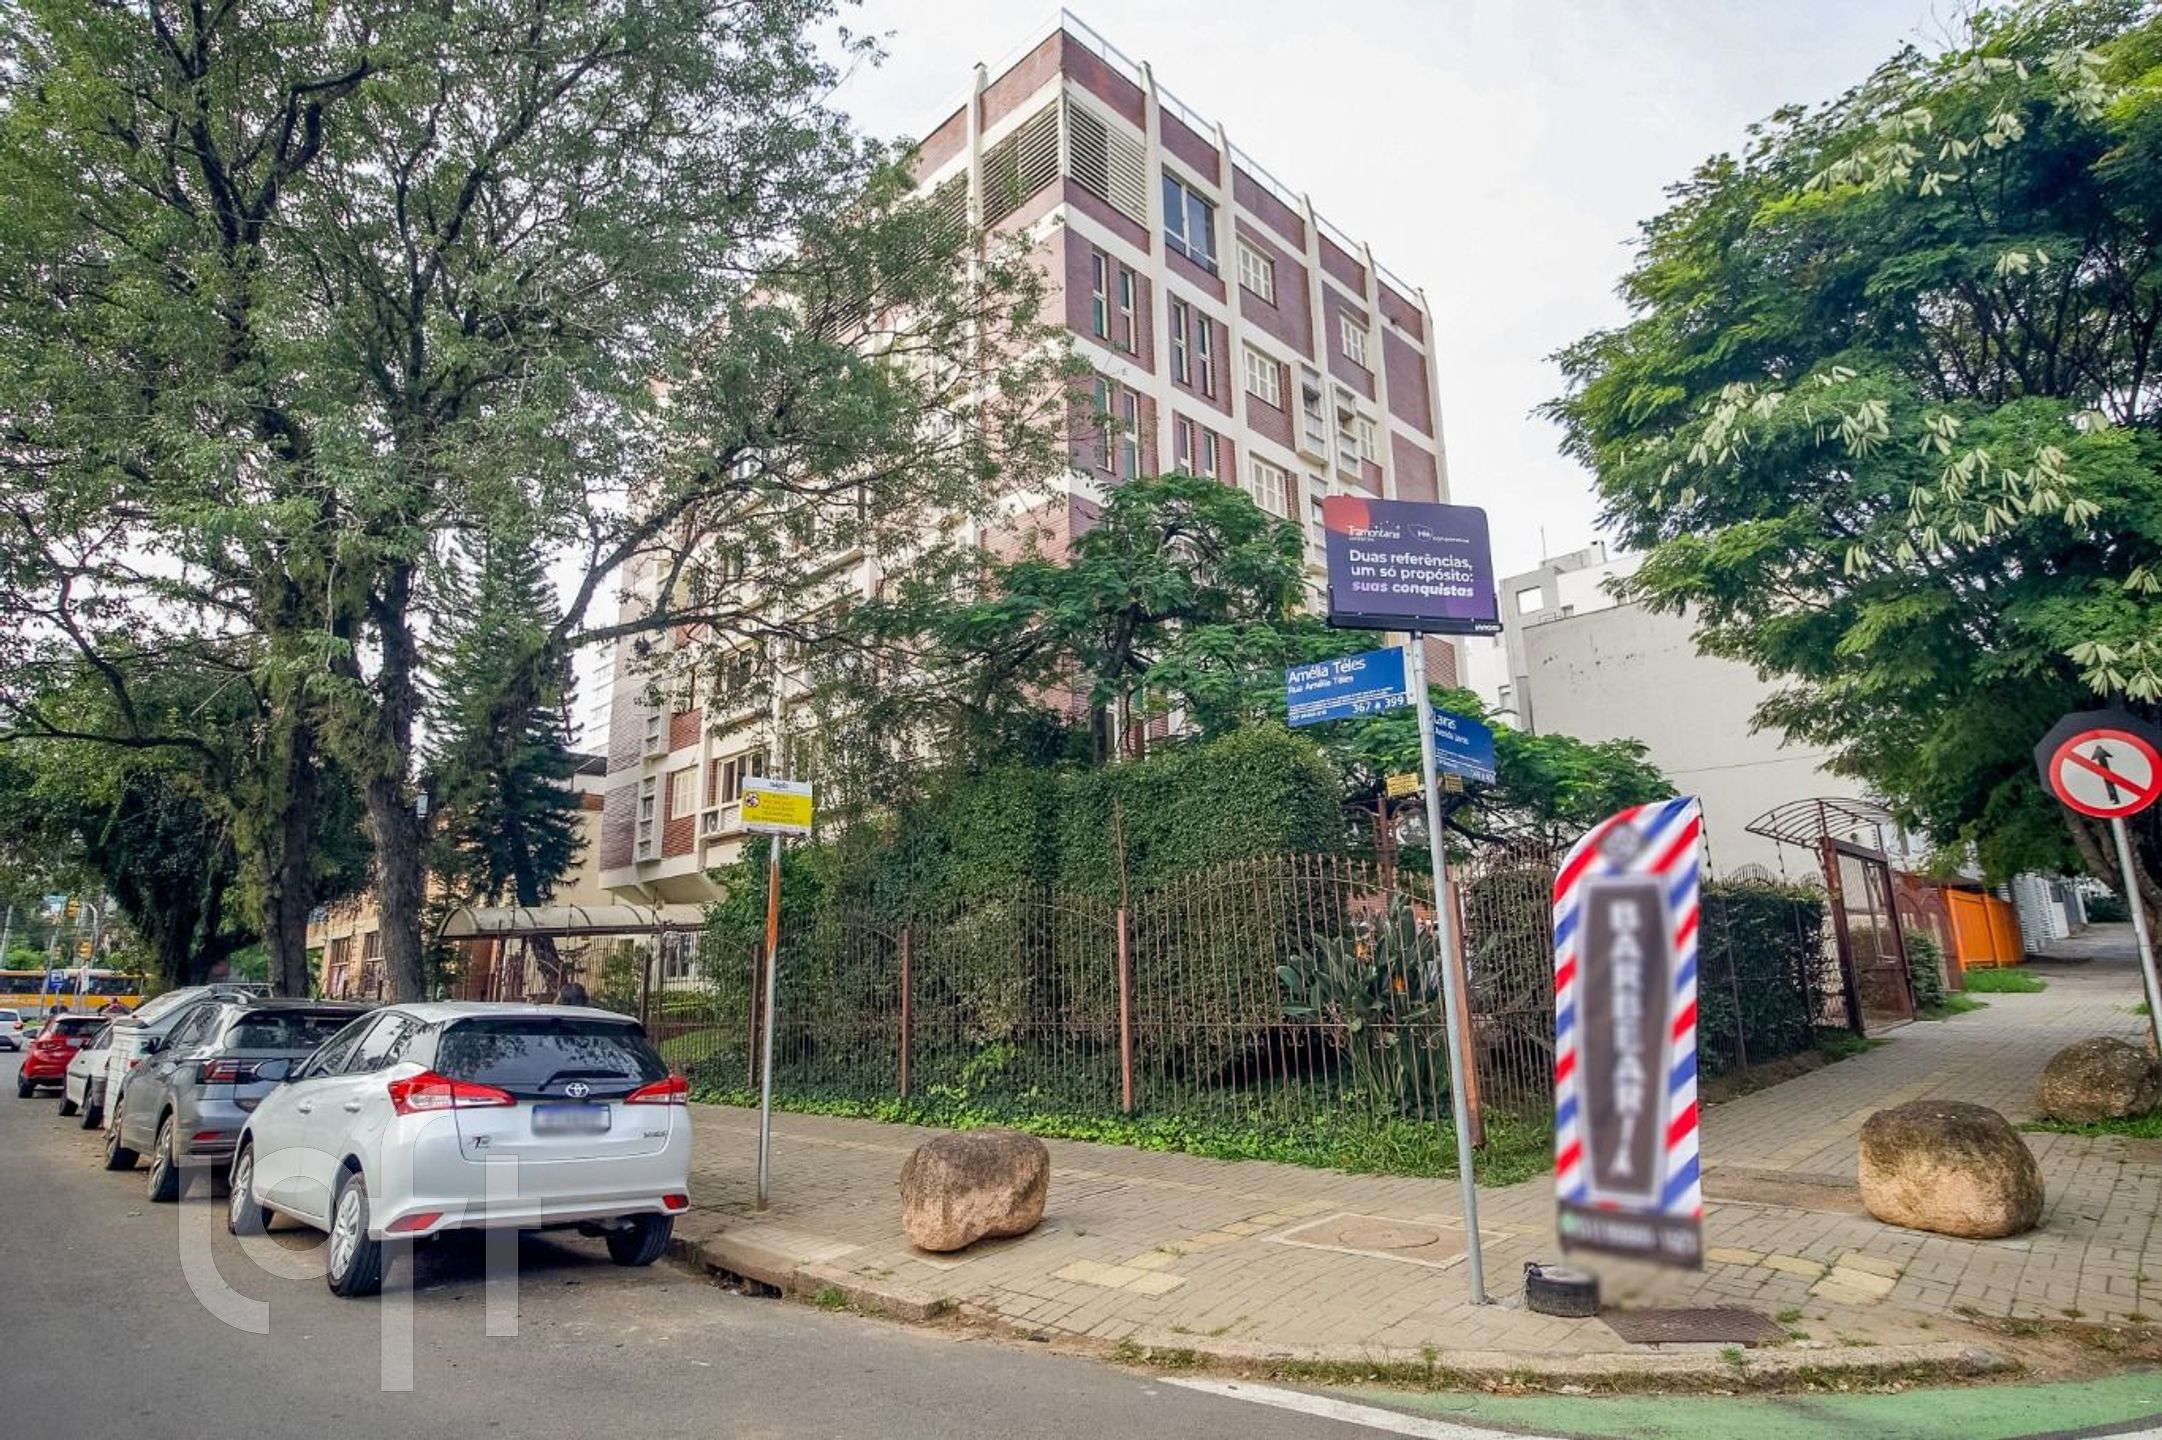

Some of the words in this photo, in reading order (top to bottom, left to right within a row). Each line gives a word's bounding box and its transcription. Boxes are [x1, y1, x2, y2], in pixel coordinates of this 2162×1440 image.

[1349, 549, 1387, 563] Duas
[1391, 552, 1473, 571] referências,
[1351, 565, 1376, 577] um
[1380, 565, 1397, 577] só
[1401, 568, 1474, 583] propósito:
[1352, 581, 1388, 592] suas
[1392, 582, 1475, 597] conquistas
[1288, 665, 1329, 684] Amélia
[1384, 696, 1404, 709] 399
